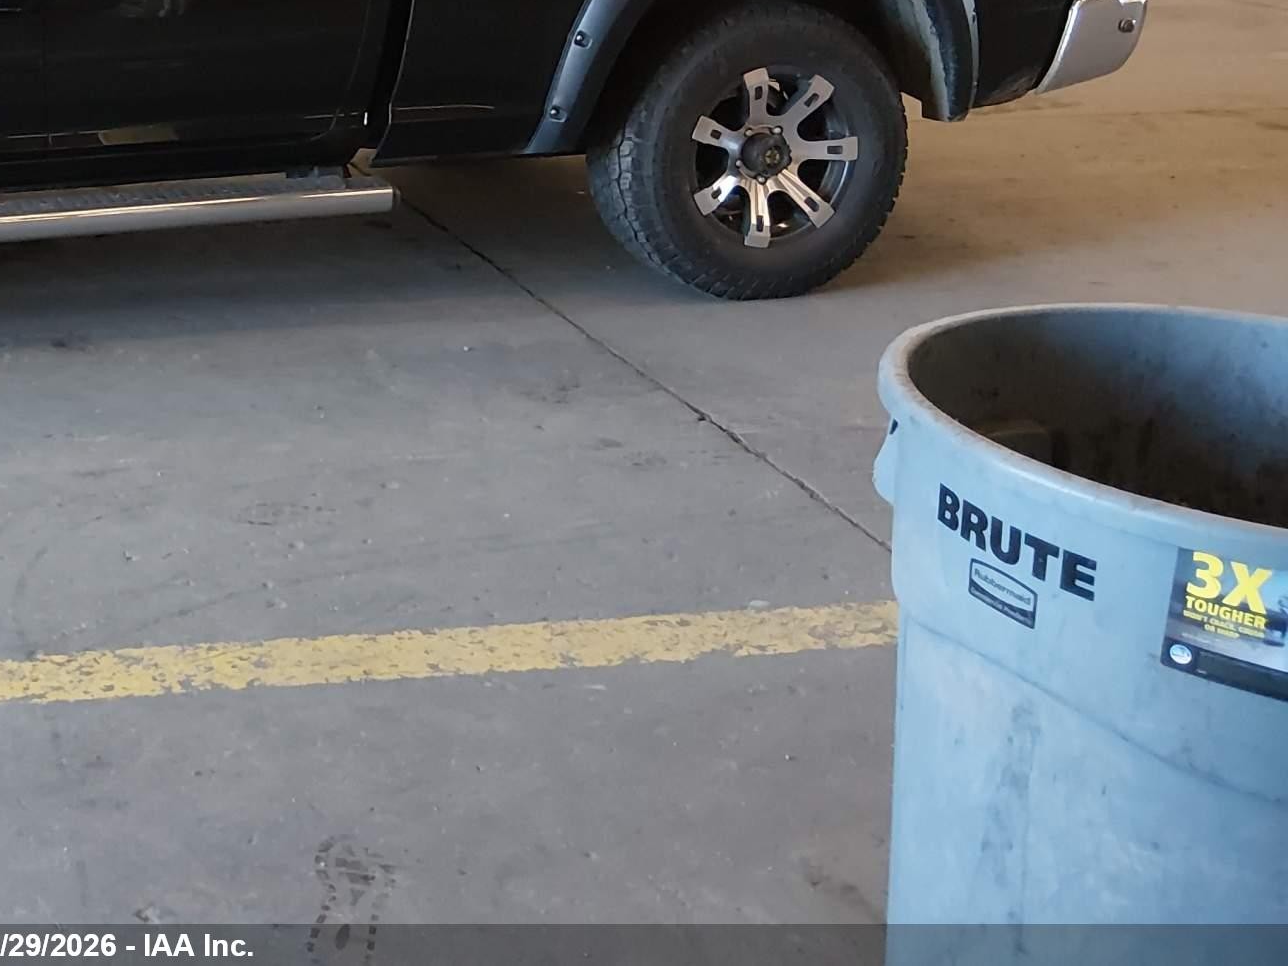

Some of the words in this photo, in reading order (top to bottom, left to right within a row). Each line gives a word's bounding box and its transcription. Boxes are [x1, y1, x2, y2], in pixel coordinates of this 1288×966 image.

[937, 482, 1097, 601] BRUTE
[1184, 595, 1268, 630] TOUGHER
[1185, 551, 1273, 615] 3X
